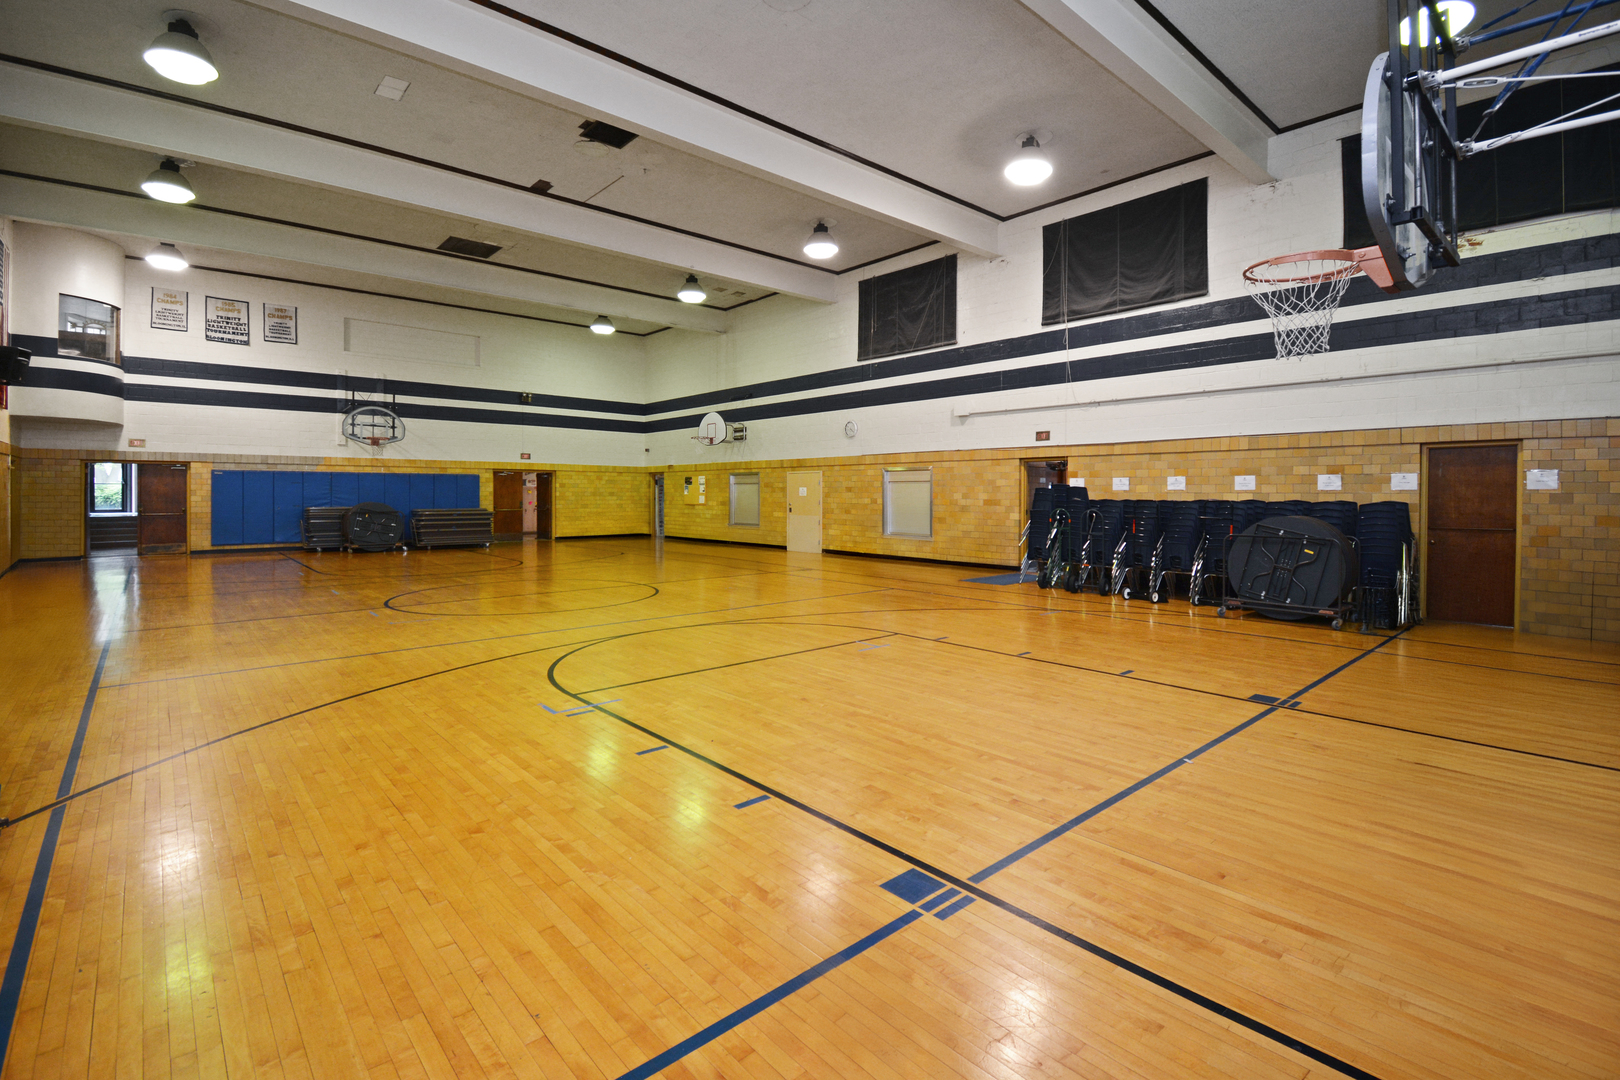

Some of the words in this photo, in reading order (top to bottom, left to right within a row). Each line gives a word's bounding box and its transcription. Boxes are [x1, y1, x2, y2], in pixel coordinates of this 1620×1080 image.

[156, 298, 183, 306] CHAMPS
[215, 306, 242, 314] CHAMPS
[207, 319, 247, 327] LIGHTWEIGHT
[206, 328, 248, 336] TOURNAMENT
[207, 324, 247, 332] BASKETBALL
